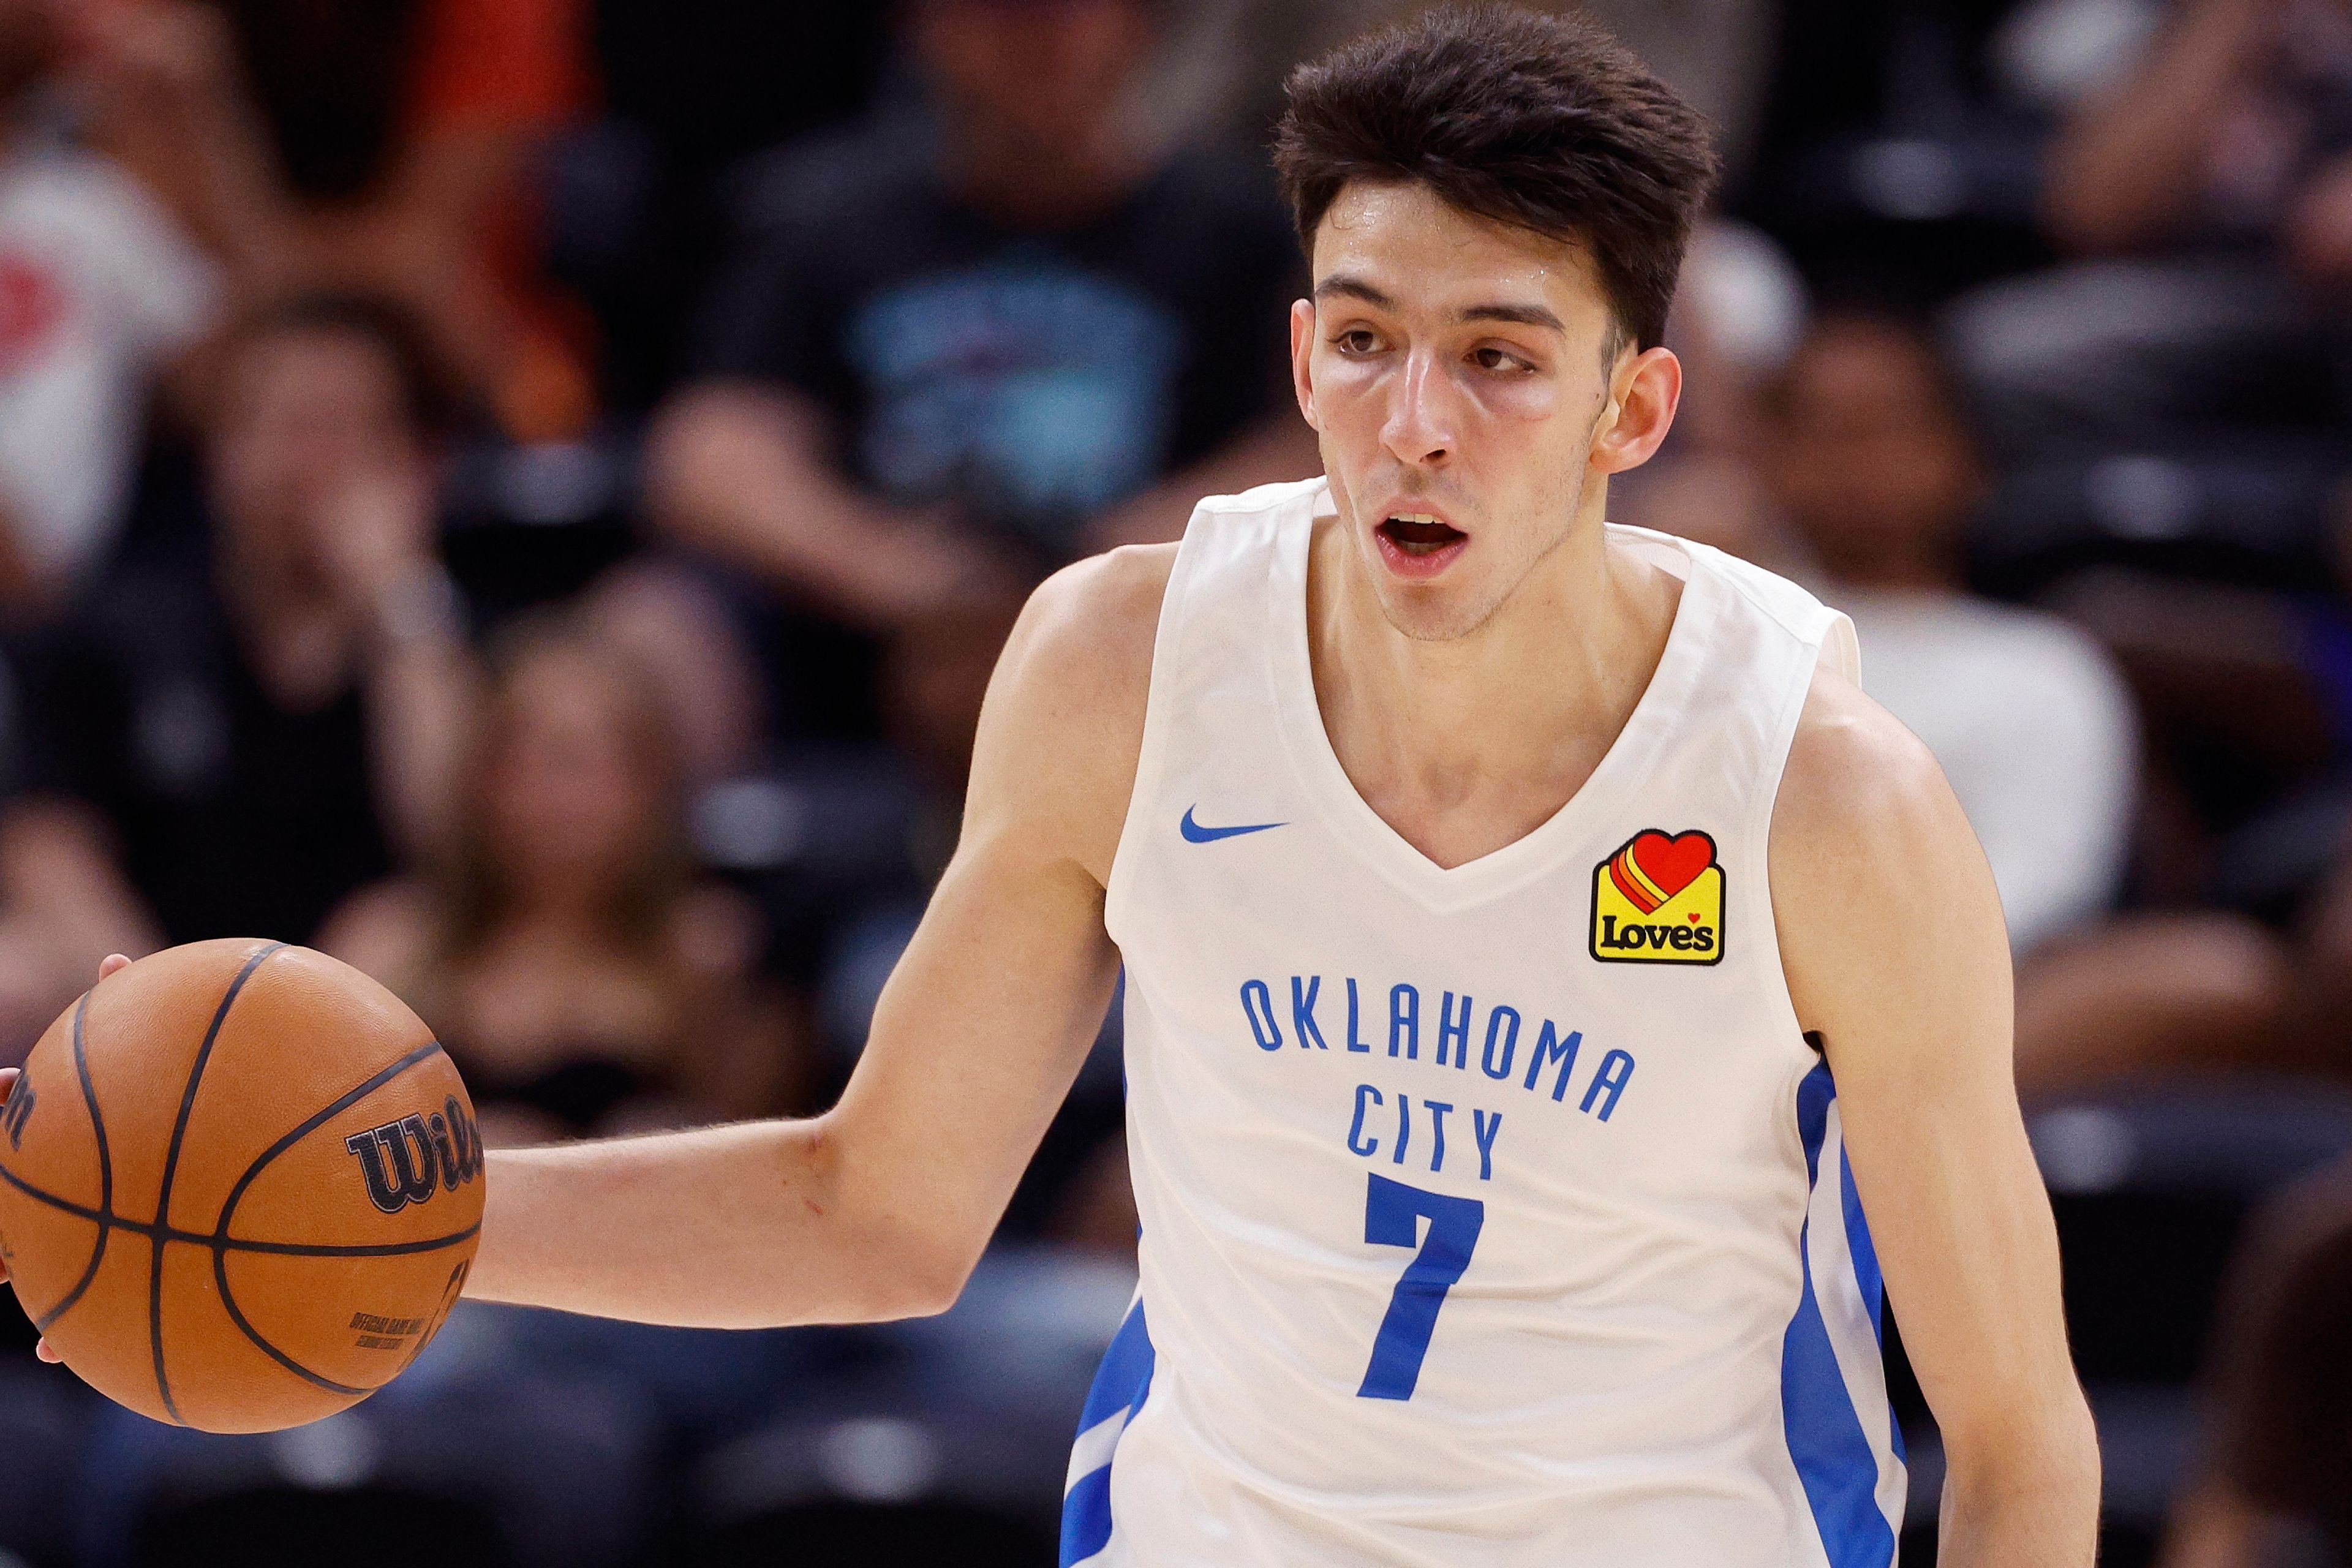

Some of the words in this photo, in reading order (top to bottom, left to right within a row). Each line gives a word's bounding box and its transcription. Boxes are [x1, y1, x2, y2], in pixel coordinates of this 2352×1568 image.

[1240, 975, 1635, 1122] OKLAHOMA
[1347, 1084, 1502, 1181] CITY
[1355, 1171, 1484, 1401] 7
